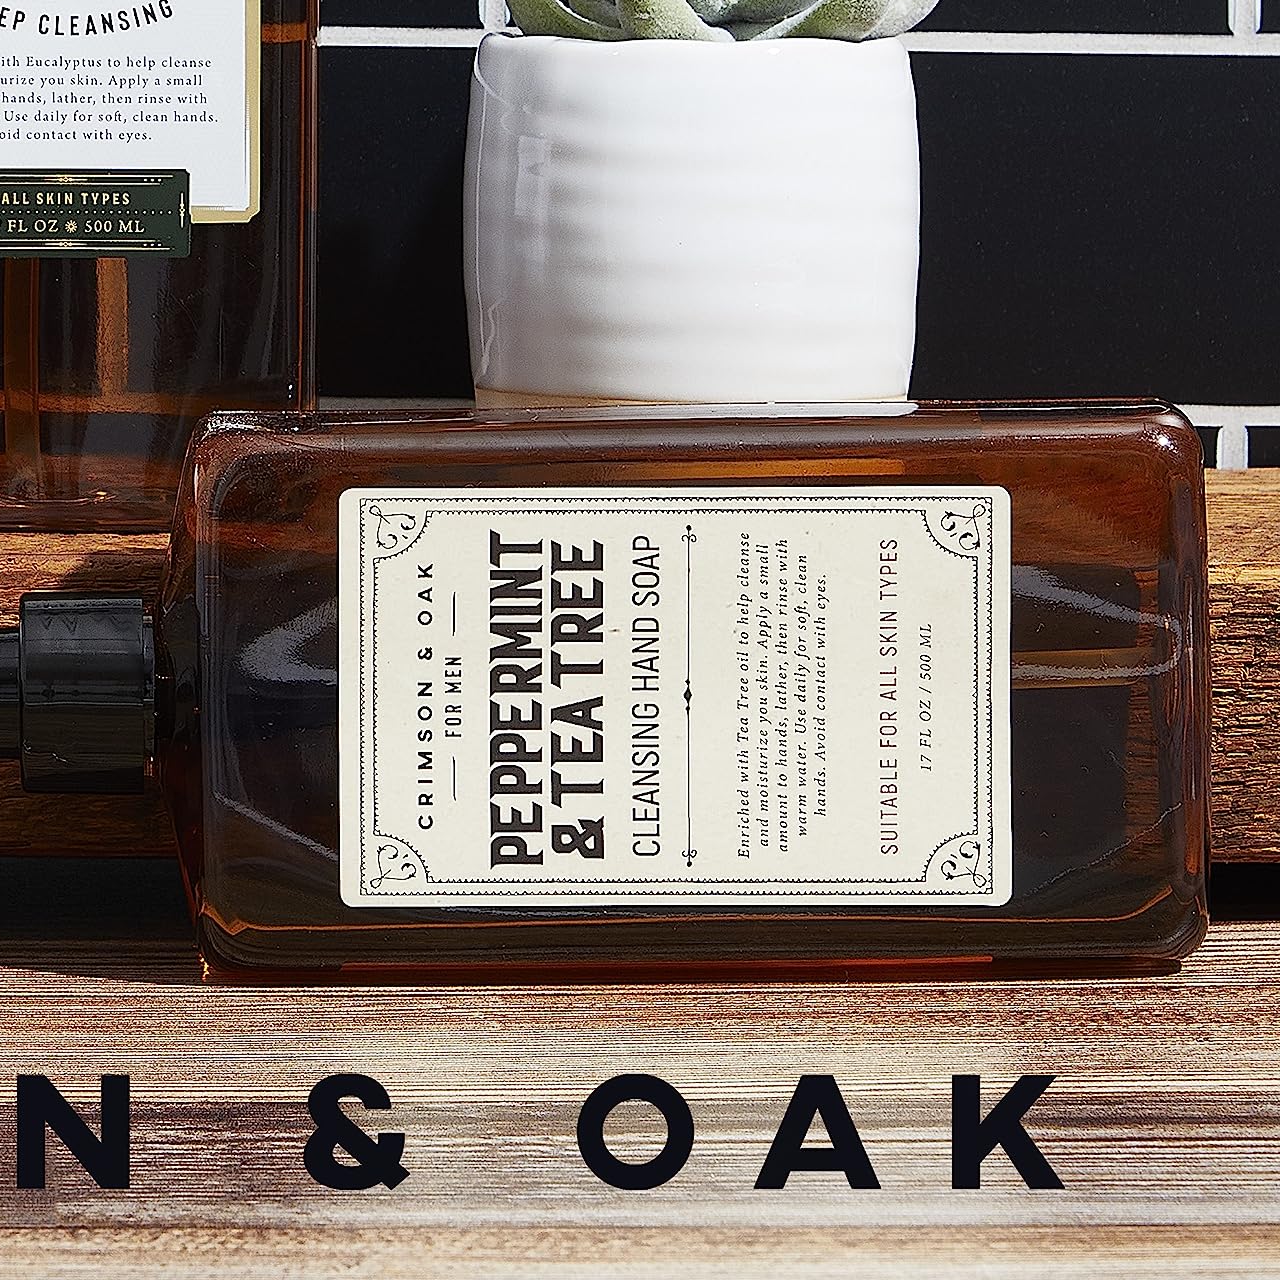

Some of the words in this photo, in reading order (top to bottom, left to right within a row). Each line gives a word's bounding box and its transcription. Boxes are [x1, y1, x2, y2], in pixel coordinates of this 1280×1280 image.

[38, 0, 174, 36] CLEANSING
[26, 57, 102, 70] Eucalyptus
[108, 59, 120, 68] to
[126, 57, 156, 70] help
[162, 57, 212, 68] cleanse
[2, 93, 47, 105] hands,
[52, 93, 96, 105] lather,
[102, 93, 132, 104] then
[138, 94, 171, 104] rinse
[177, 94, 207, 104] with
[40, 77, 64, 88] you
[70, 75, 103, 86] skin.
[108, 75, 149, 89] Apply
[166, 75, 203, 86] small
[4, 111, 28, 122] Use
[34, 111, 68, 125] daily
[73, 110, 93, 122] for
[98, 111, 127, 123] soft,
[132, 111, 168, 122] clean
[174, 111, 218, 123] hands.
[26, 131, 77, 140] contact
[82, 130, 113, 140] with
[118, 132, 152, 143] eyes.
[1, 192, 30, 205] ALL
[36, 192, 73, 205] SKIN
[81, 193, 130, 205] TYPES
[7, 221, 28, 232] FL
[34, 220, 59, 232] OZ
[85, 221, 112, 232] 500
[119, 221, 144, 232] ML
[632, 535, 660, 606] SOAP
[737, 532, 751, 587] cleanse
[756, 544, 770, 585] small
[775, 539, 788, 571] with
[880, 539, 898, 601] TYPES
[794, 555, 808, 594] clean
[816, 574, 829, 610] eyes.
[418, 563, 434, 625] OAK
[737, 594, 753, 625] help
[776, 579, 789, 616] rinse
[551, 539, 604, 689] TREE
[756, 606, 772, 649] Apply
[794, 599, 810, 631] soft,
[738, 631, 750, 645] to
[775, 622, 789, 654] then
[794, 638, 811, 660] for
[813, 617, 827, 649] with
[880, 611, 898, 657] SKIN
[919, 624, 932, 648] ML
[418, 646, 433, 661] &
[632, 617, 660, 691] HAND
[737, 651, 750, 671] oil
[919, 655, 932, 680] 500
[445, 656, 462, 694] MEN
[756, 654, 769, 690] skin.
[775, 661, 790, 710] lather,
[794, 664, 811, 702] daily
[815, 656, 827, 710] contact
[880, 666, 898, 701] ALL
[489, 529, 544, 869] PEPPERMINT
[737, 677, 750, 710] Tree
[760, 697, 772, 723] you
[919, 700, 932, 722] OZ
[444, 704, 462, 737] FOR
[737, 717, 750, 742] Tea
[794, 708, 808, 734] Use
[880, 711, 898, 748] FOR
[920, 728, 932, 747] FL
[417, 681, 434, 830] CRIMSON
[551, 696, 604, 808] TEA
[775, 717, 791, 767] hands,
[813, 717, 827, 761] Avoid
[632, 703, 660, 857] CLEANSING
[737, 750, 750, 782] with
[757, 730, 769, 811] moisturize
[777, 773, 788, 787] to
[796, 741, 808, 787] water.
[920, 755, 932, 772] 17
[813, 767, 827, 816] hands.
[880, 759, 898, 855] SUITABLE
[737, 789, 751, 858] Enriched
[756, 818, 769, 847] and
[778, 794, 789, 852] amount
[797, 794, 808, 836] warm
[551, 816, 605, 860] &
